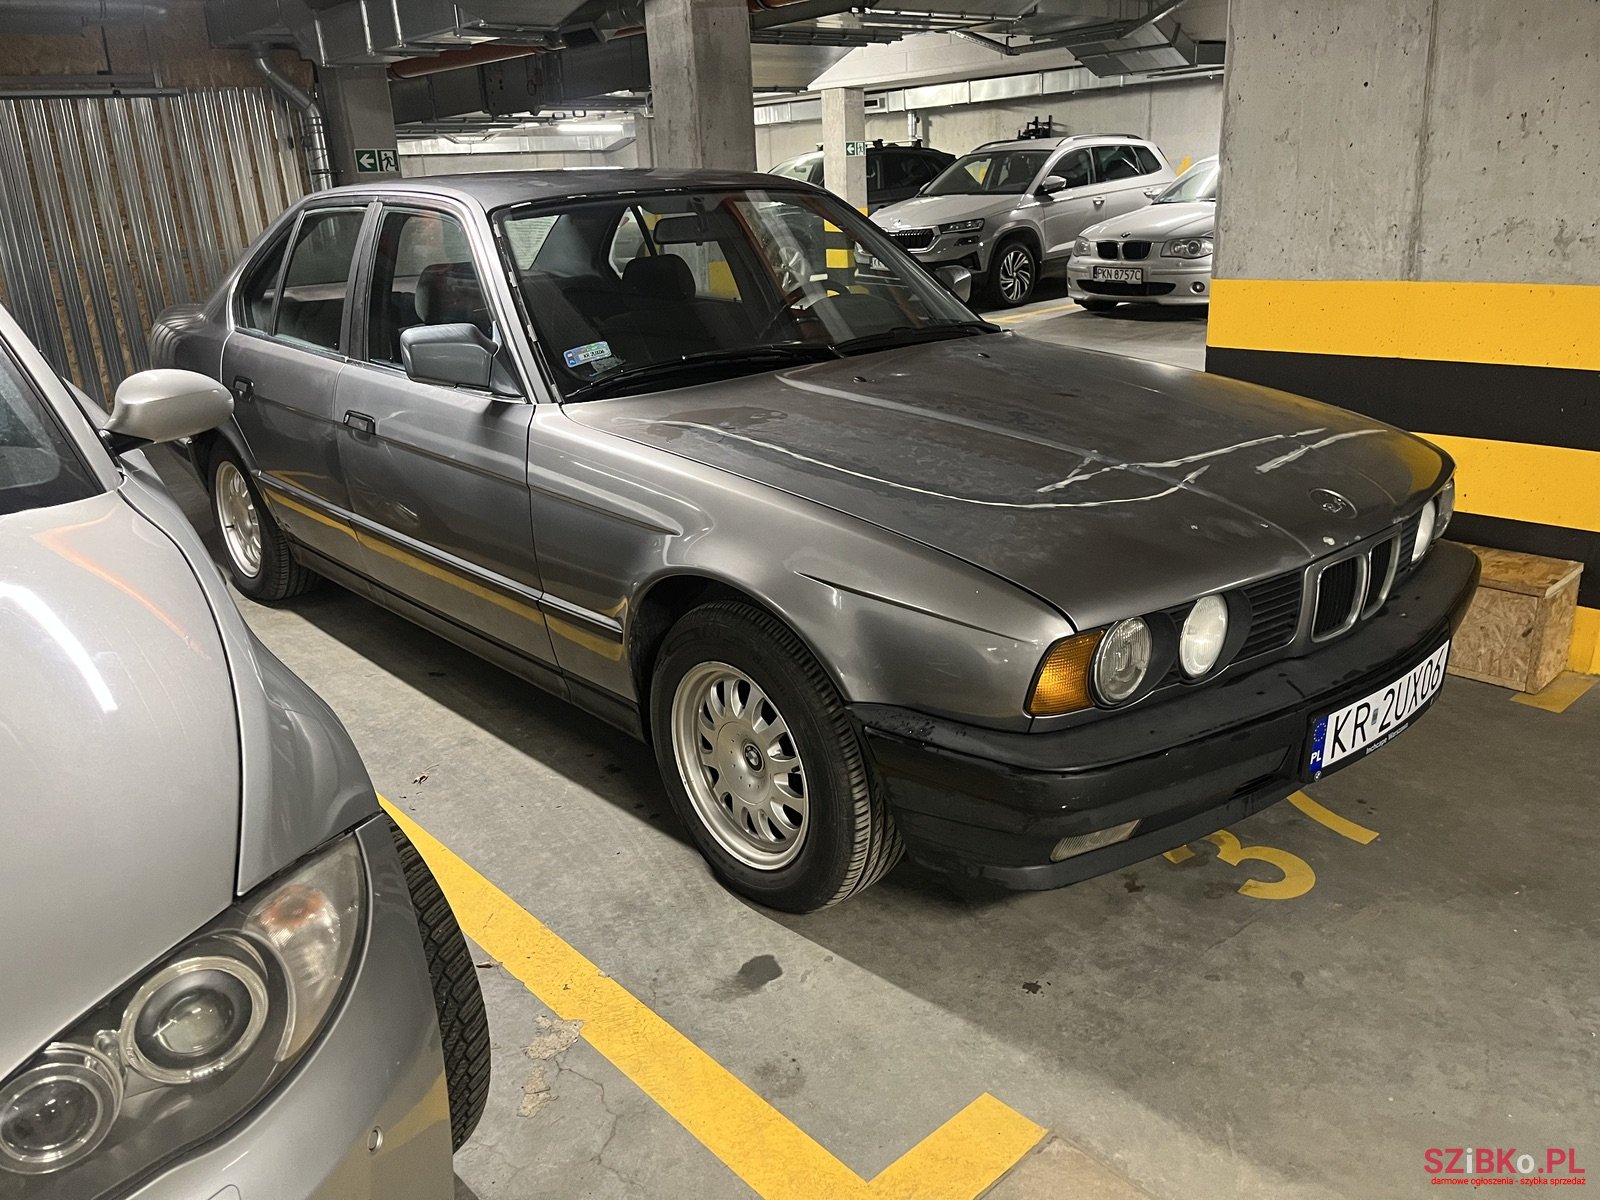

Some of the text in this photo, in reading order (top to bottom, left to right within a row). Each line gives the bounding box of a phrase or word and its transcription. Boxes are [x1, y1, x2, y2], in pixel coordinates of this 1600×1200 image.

[1097, 268, 1141, 281] PKN 8757C
[1331, 647, 1445, 759] KR 2UX06
[1310, 750, 1322, 765] PL
